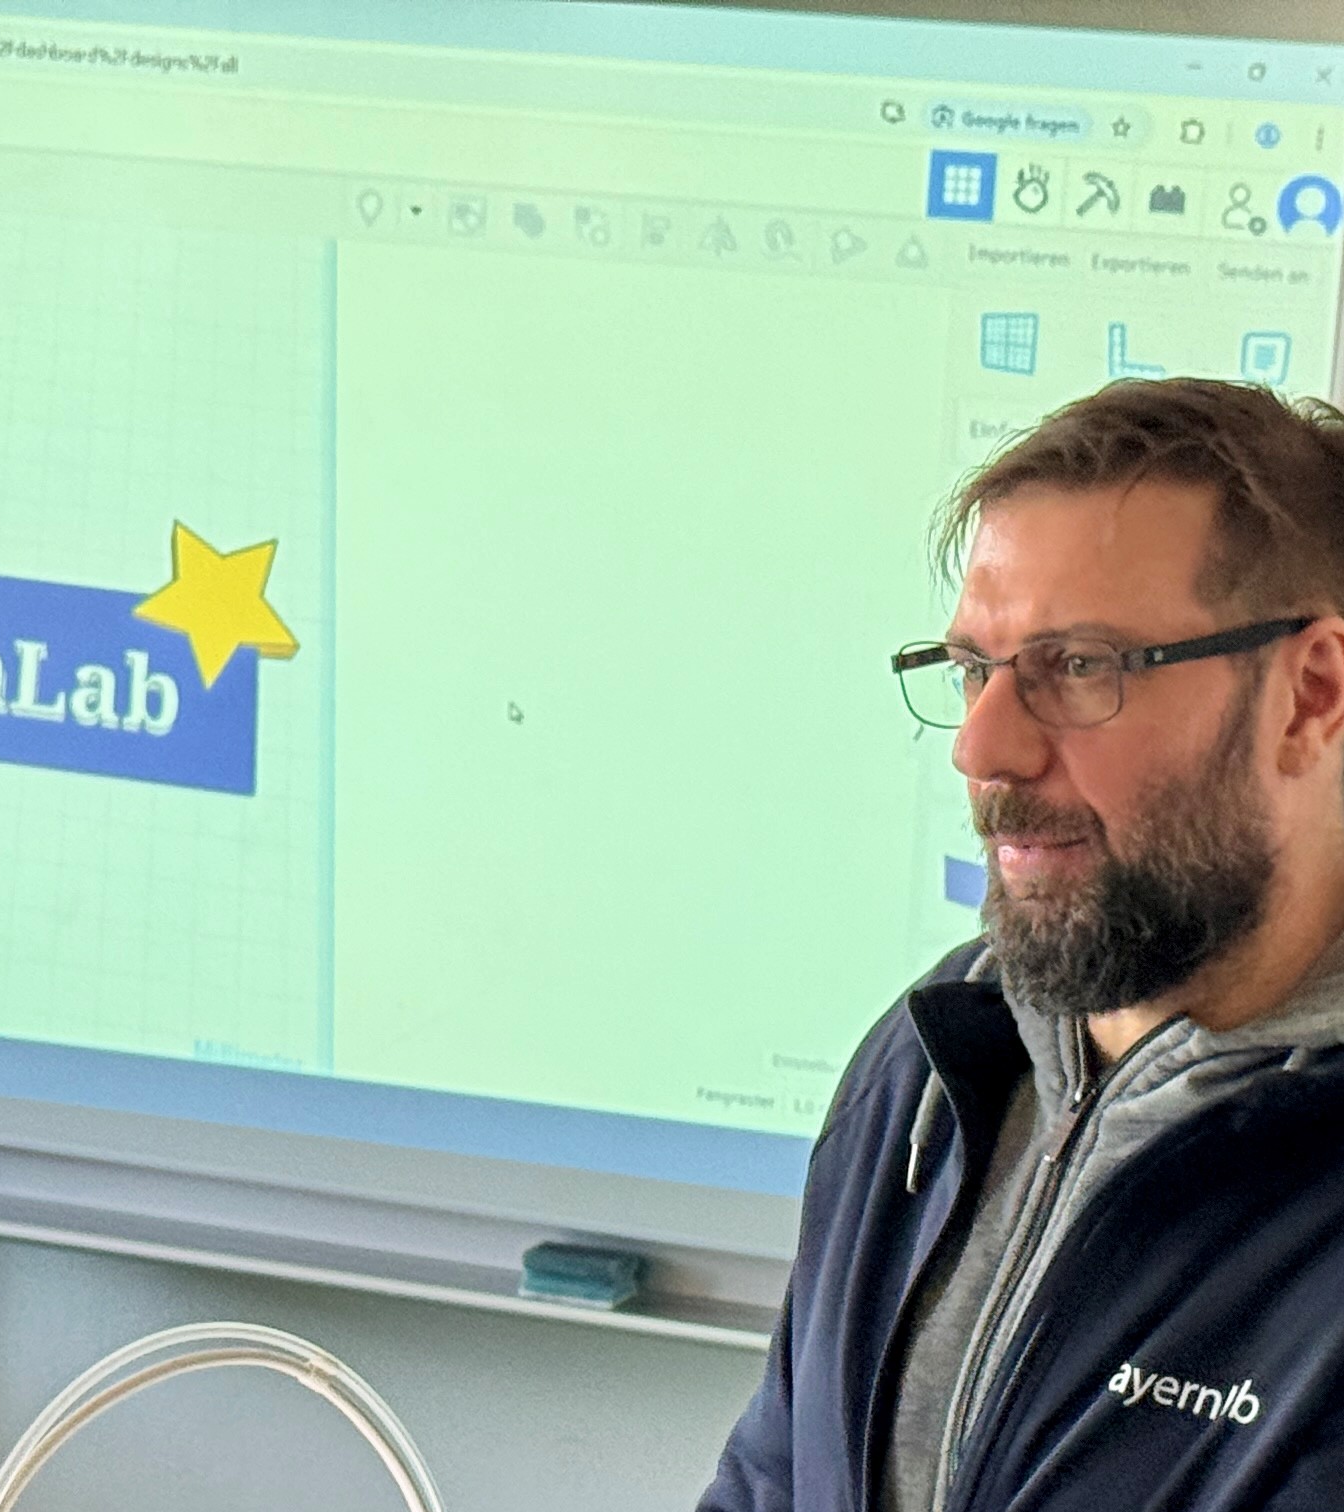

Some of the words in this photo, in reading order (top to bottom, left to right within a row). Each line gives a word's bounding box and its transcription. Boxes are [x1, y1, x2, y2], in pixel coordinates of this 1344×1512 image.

[962, 110, 1020, 134] Google
[1025, 113, 1080, 138] fragen
[968, 243, 1070, 267] Importieren
[1091, 252, 1191, 275] Exportieren
[1216, 262, 1283, 284] Senden
[1286, 269, 1309, 284] an
[697, 1087, 775, 1109] Fangraster
